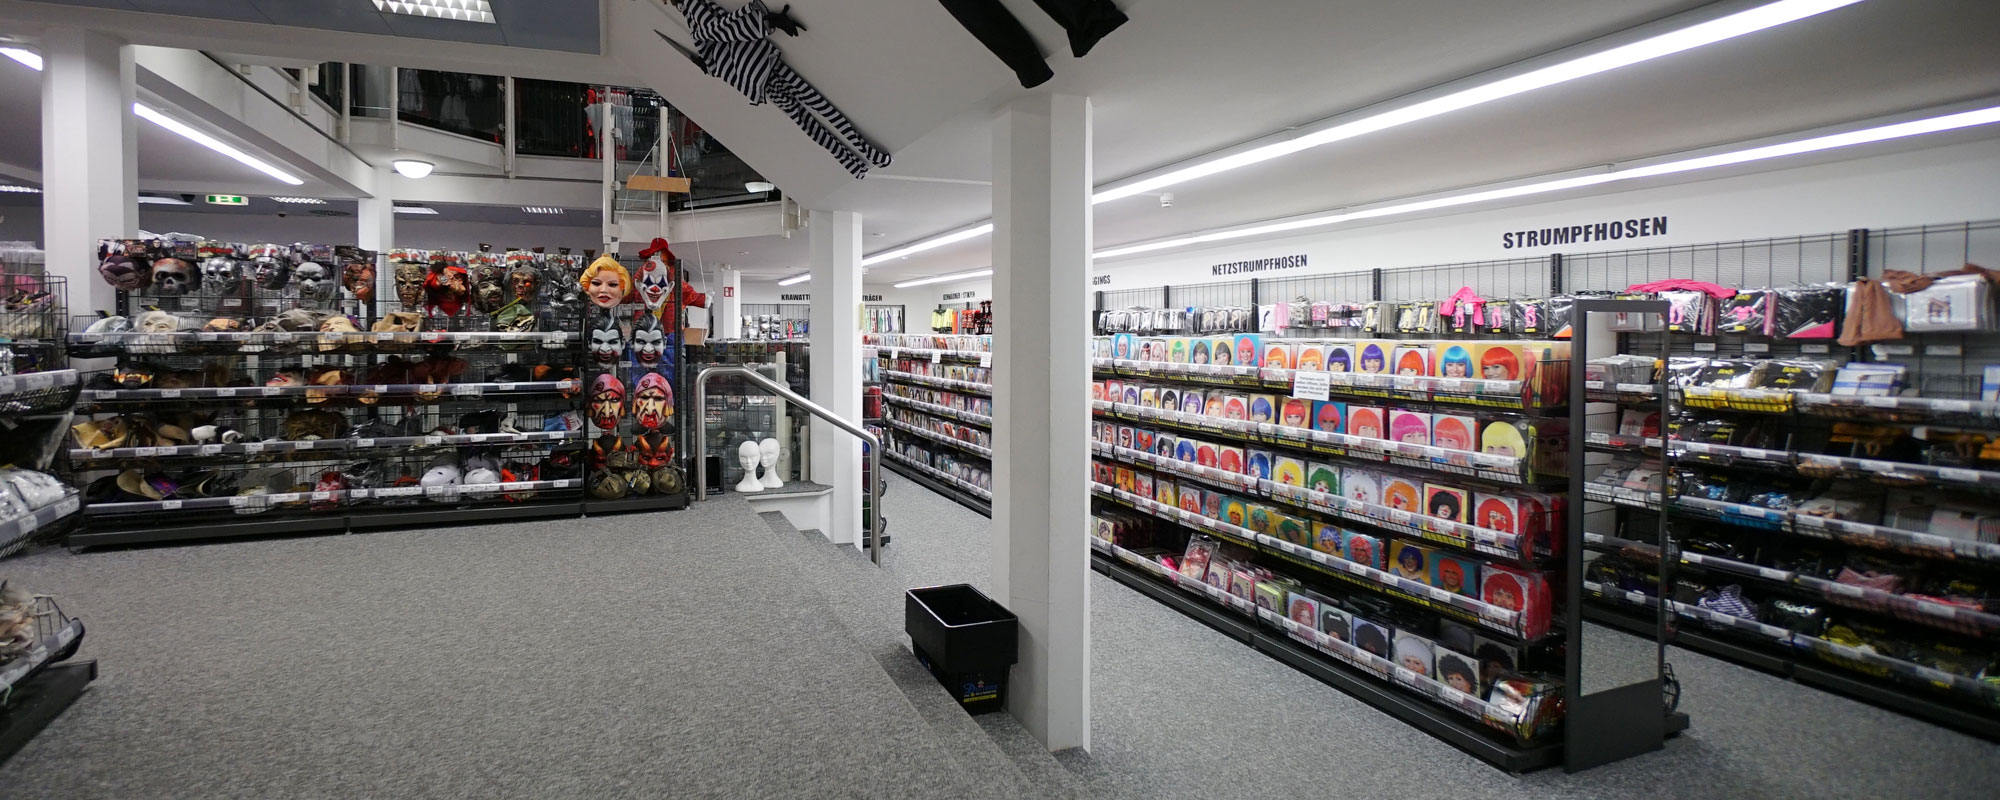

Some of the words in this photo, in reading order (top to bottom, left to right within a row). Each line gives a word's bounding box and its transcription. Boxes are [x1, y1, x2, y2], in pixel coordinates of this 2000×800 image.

[1503, 216, 1668, 249] STRUMPFHOSEN
[1212, 254, 1308, 276] NETZSTRUMPFHOSEN
[1092, 274, 1111, 286] GINGS
